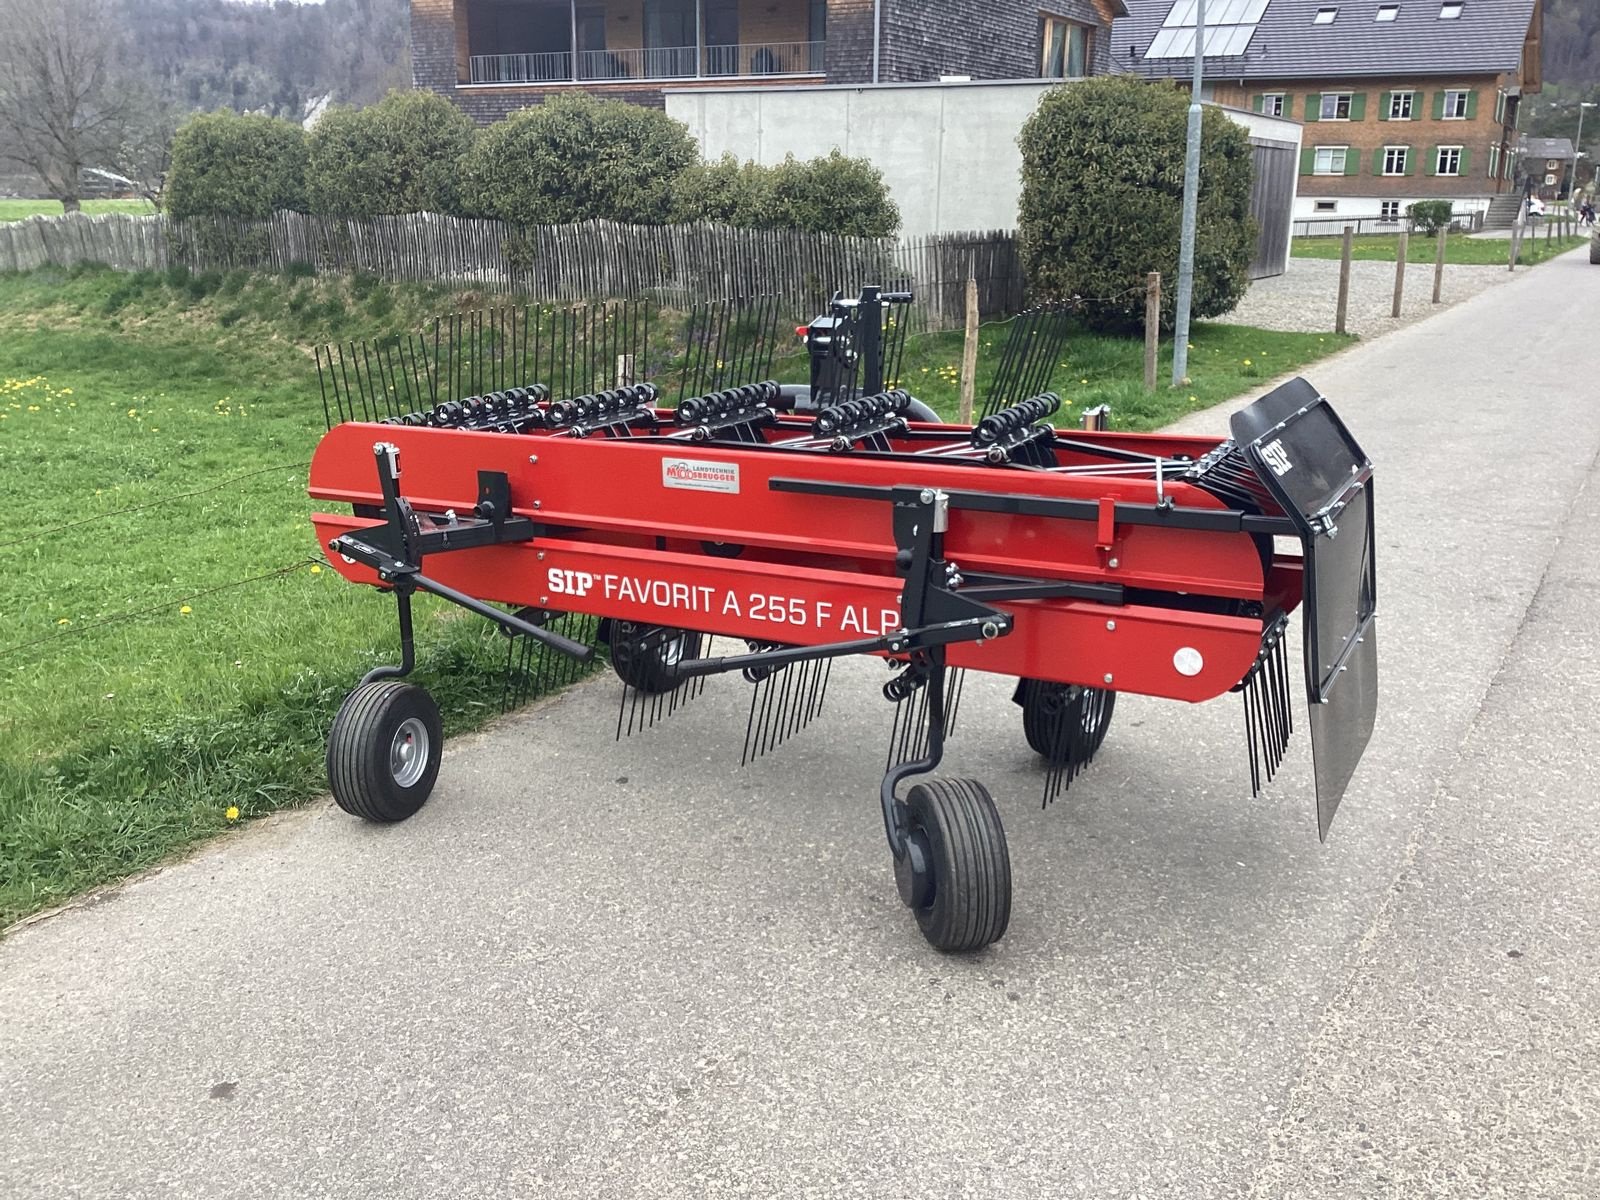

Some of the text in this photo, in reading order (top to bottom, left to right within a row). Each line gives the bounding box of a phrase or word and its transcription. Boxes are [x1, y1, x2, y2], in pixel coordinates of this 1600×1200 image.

[692, 465, 736, 475] LANDTECHNIK
[604, 574, 715, 613] FAVORIT
[722, 590, 741, 617] A
[749, 593, 807, 626] 255
[816, 601, 833, 628] F
[840, 605, 900, 636] ALP
